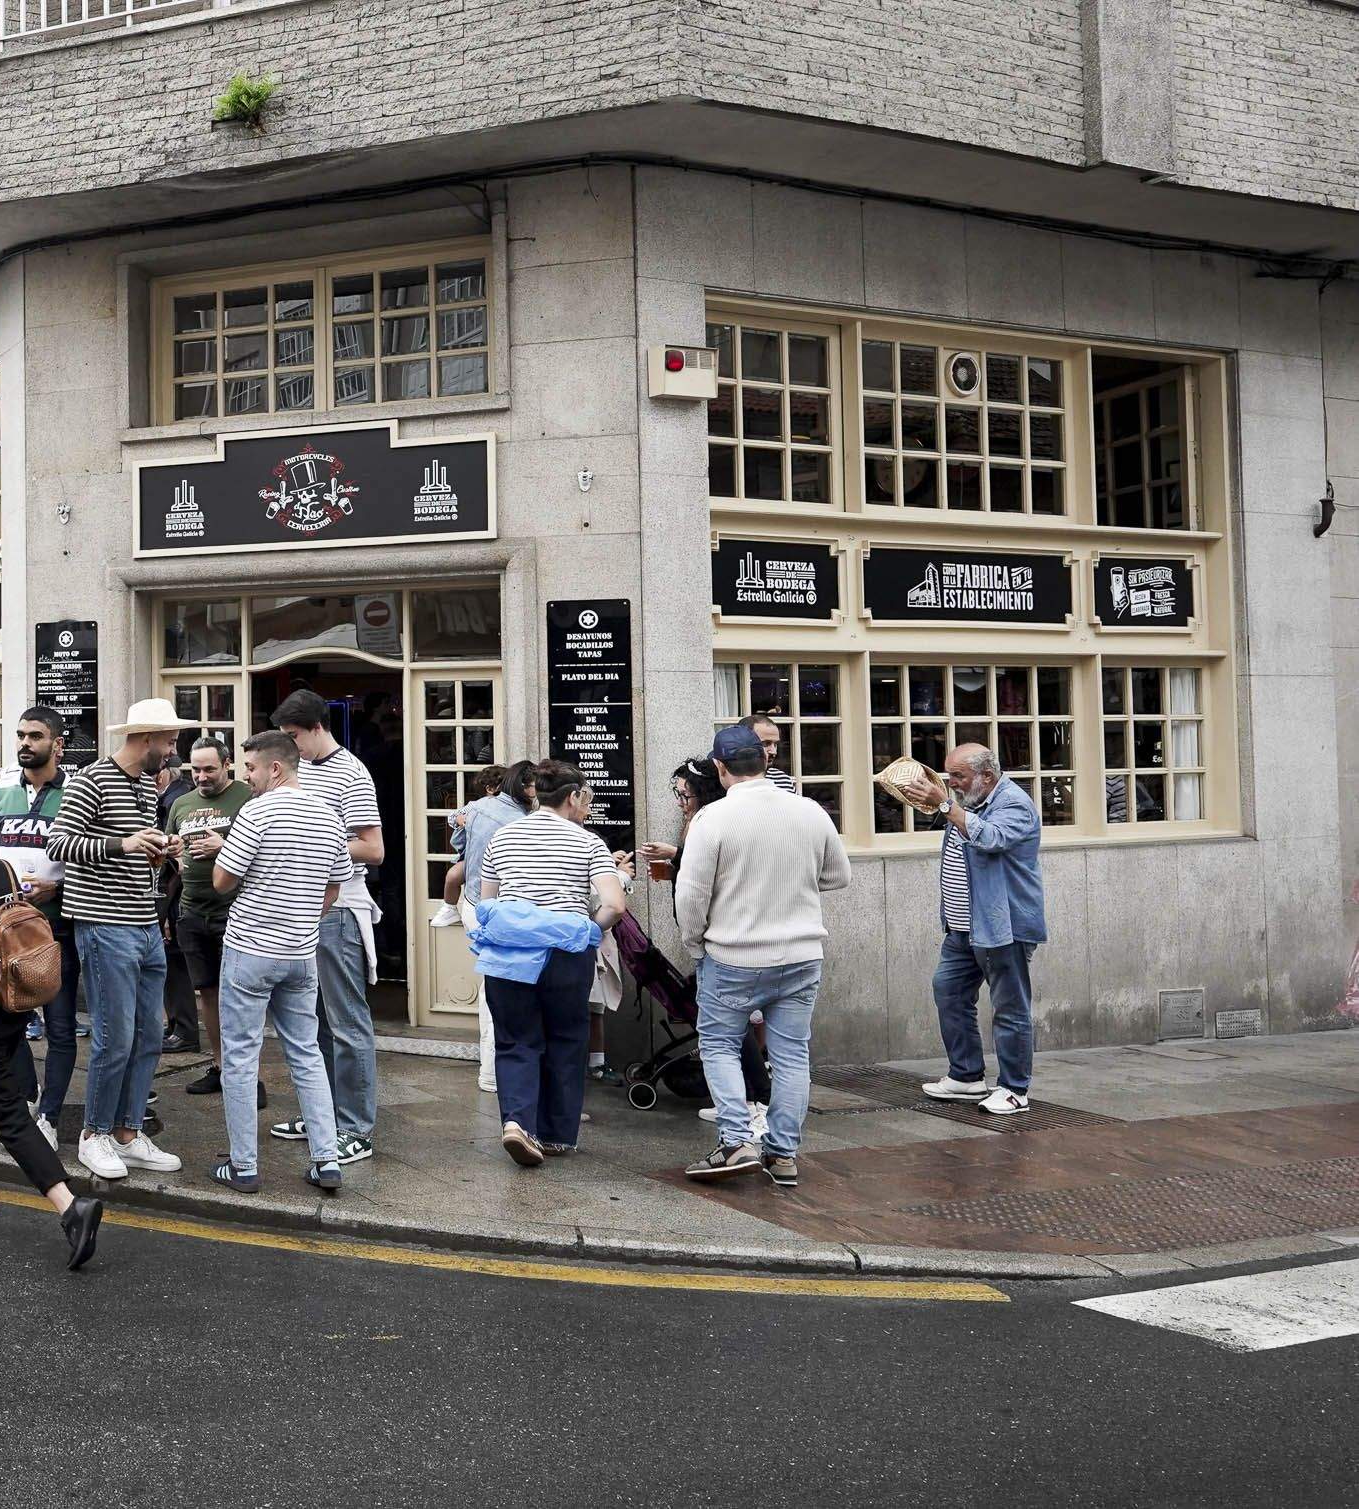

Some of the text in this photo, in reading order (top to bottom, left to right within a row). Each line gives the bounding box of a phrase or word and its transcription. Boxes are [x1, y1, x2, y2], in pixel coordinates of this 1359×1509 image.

[284, 454, 335, 466] MOTORCYCLES
[414, 506, 458, 514] BODEGA
[765, 560, 815, 571] CERVEZA
[943, 566, 956, 575] COMO
[943, 576, 949, 584] EN
[956, 564, 1010, 590] FABRICA
[1012, 568, 1032, 587] EN TU
[766, 579, 815, 590] BODEGA
[737, 589, 804, 603] Estrella Galicia
[944, 589, 1033, 610] ESTABLECIMIENTO
[566, 632, 612, 641] DESAYUNOS
[565, 641, 613, 649] BOCADILLOS
[577, 650, 602, 658] TAPAS
[561, 673, 619, 681] PLATO DEL DIA
[567, 733, 616, 741] NACIONALES
[564, 742, 619, 750] IMPORTACION
[579, 752, 603, 760] VINOS
[1, 819, 54, 835] KAN
[0, 835, 43, 844] SPOR
